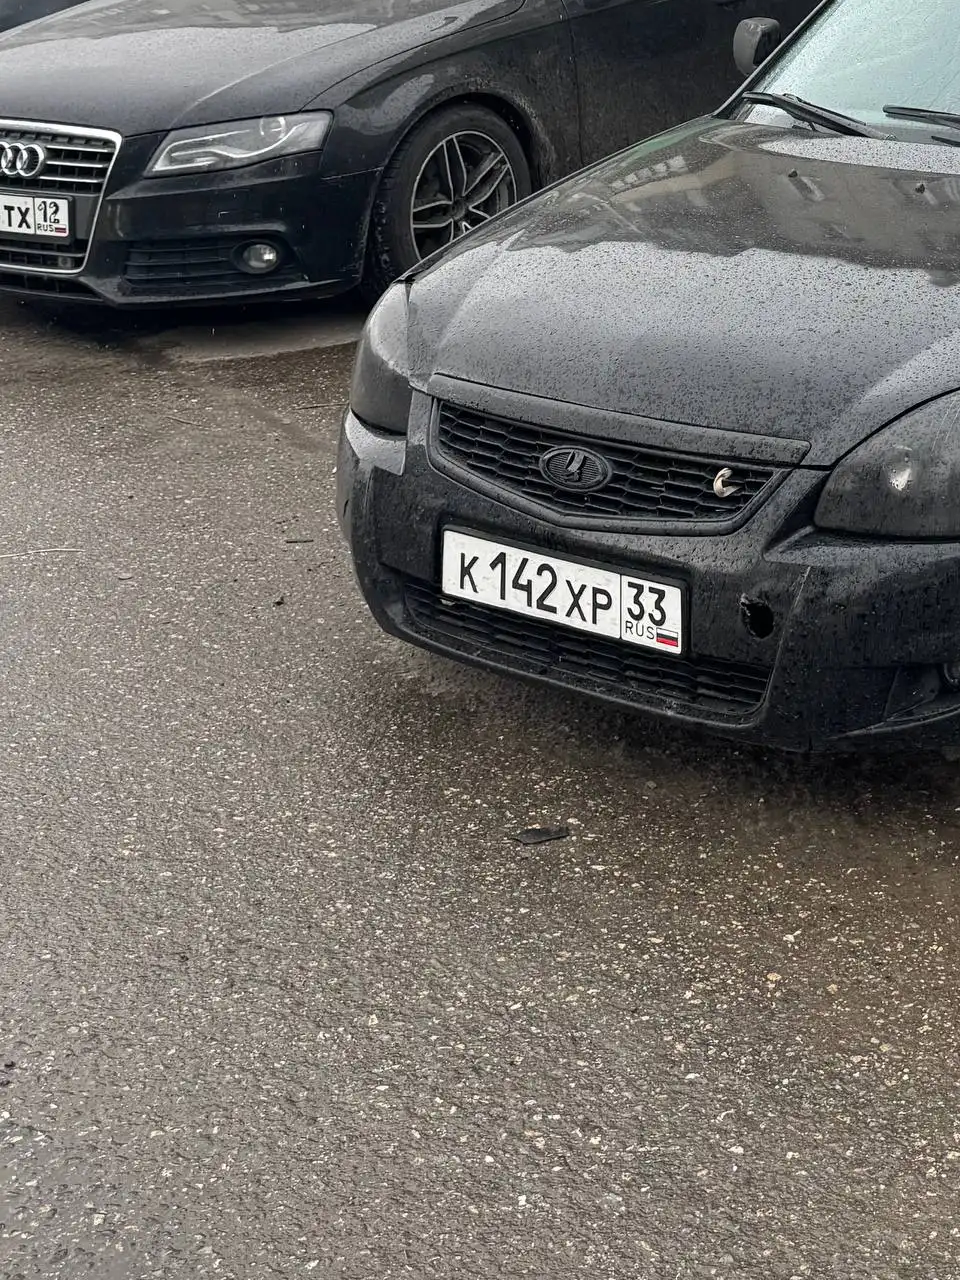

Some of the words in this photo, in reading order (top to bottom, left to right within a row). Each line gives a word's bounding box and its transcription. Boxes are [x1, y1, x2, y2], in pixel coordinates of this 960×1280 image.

[37, 201, 60, 223] 12
[37, 223, 54, 232] RUS
[627, 581, 667, 628] 33
[625, 620, 655, 641] RUS
